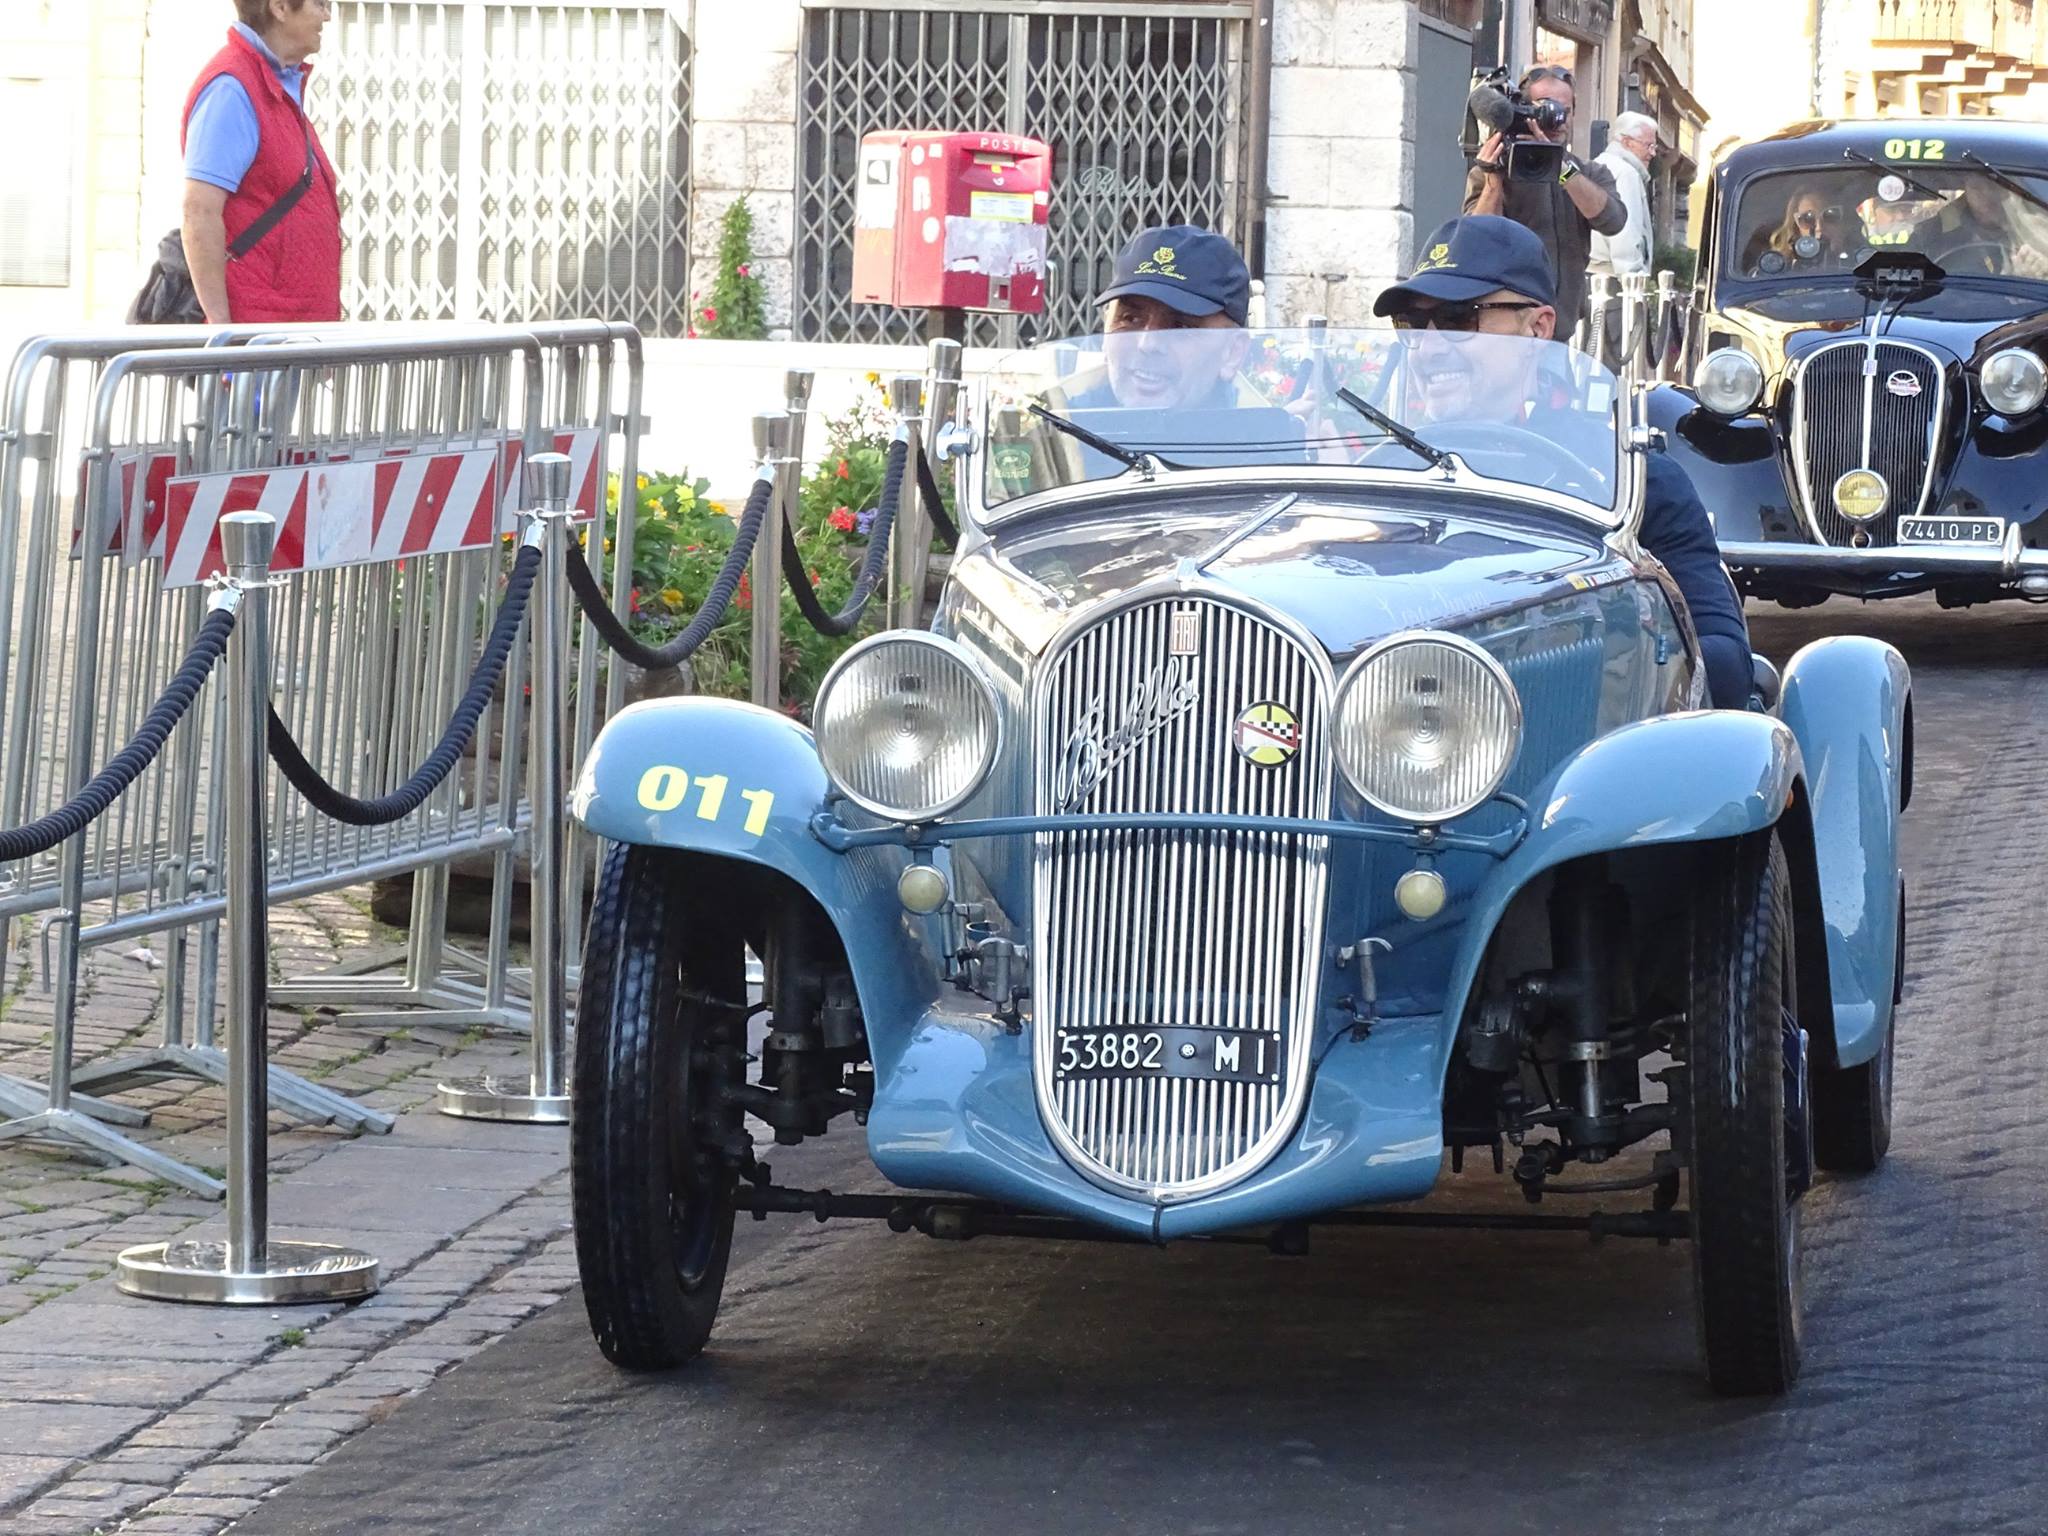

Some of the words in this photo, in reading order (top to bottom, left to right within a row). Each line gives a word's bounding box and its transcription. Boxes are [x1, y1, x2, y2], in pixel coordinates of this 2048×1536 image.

[980, 137, 1031, 153] POSTE
[1884, 138, 1945, 160] 012
[1905, 521, 1959, 540] 74410
[1173, 615, 1196, 651] FIAT
[637, 764, 775, 837] 011
[1059, 1032, 1164, 1071] 53882
